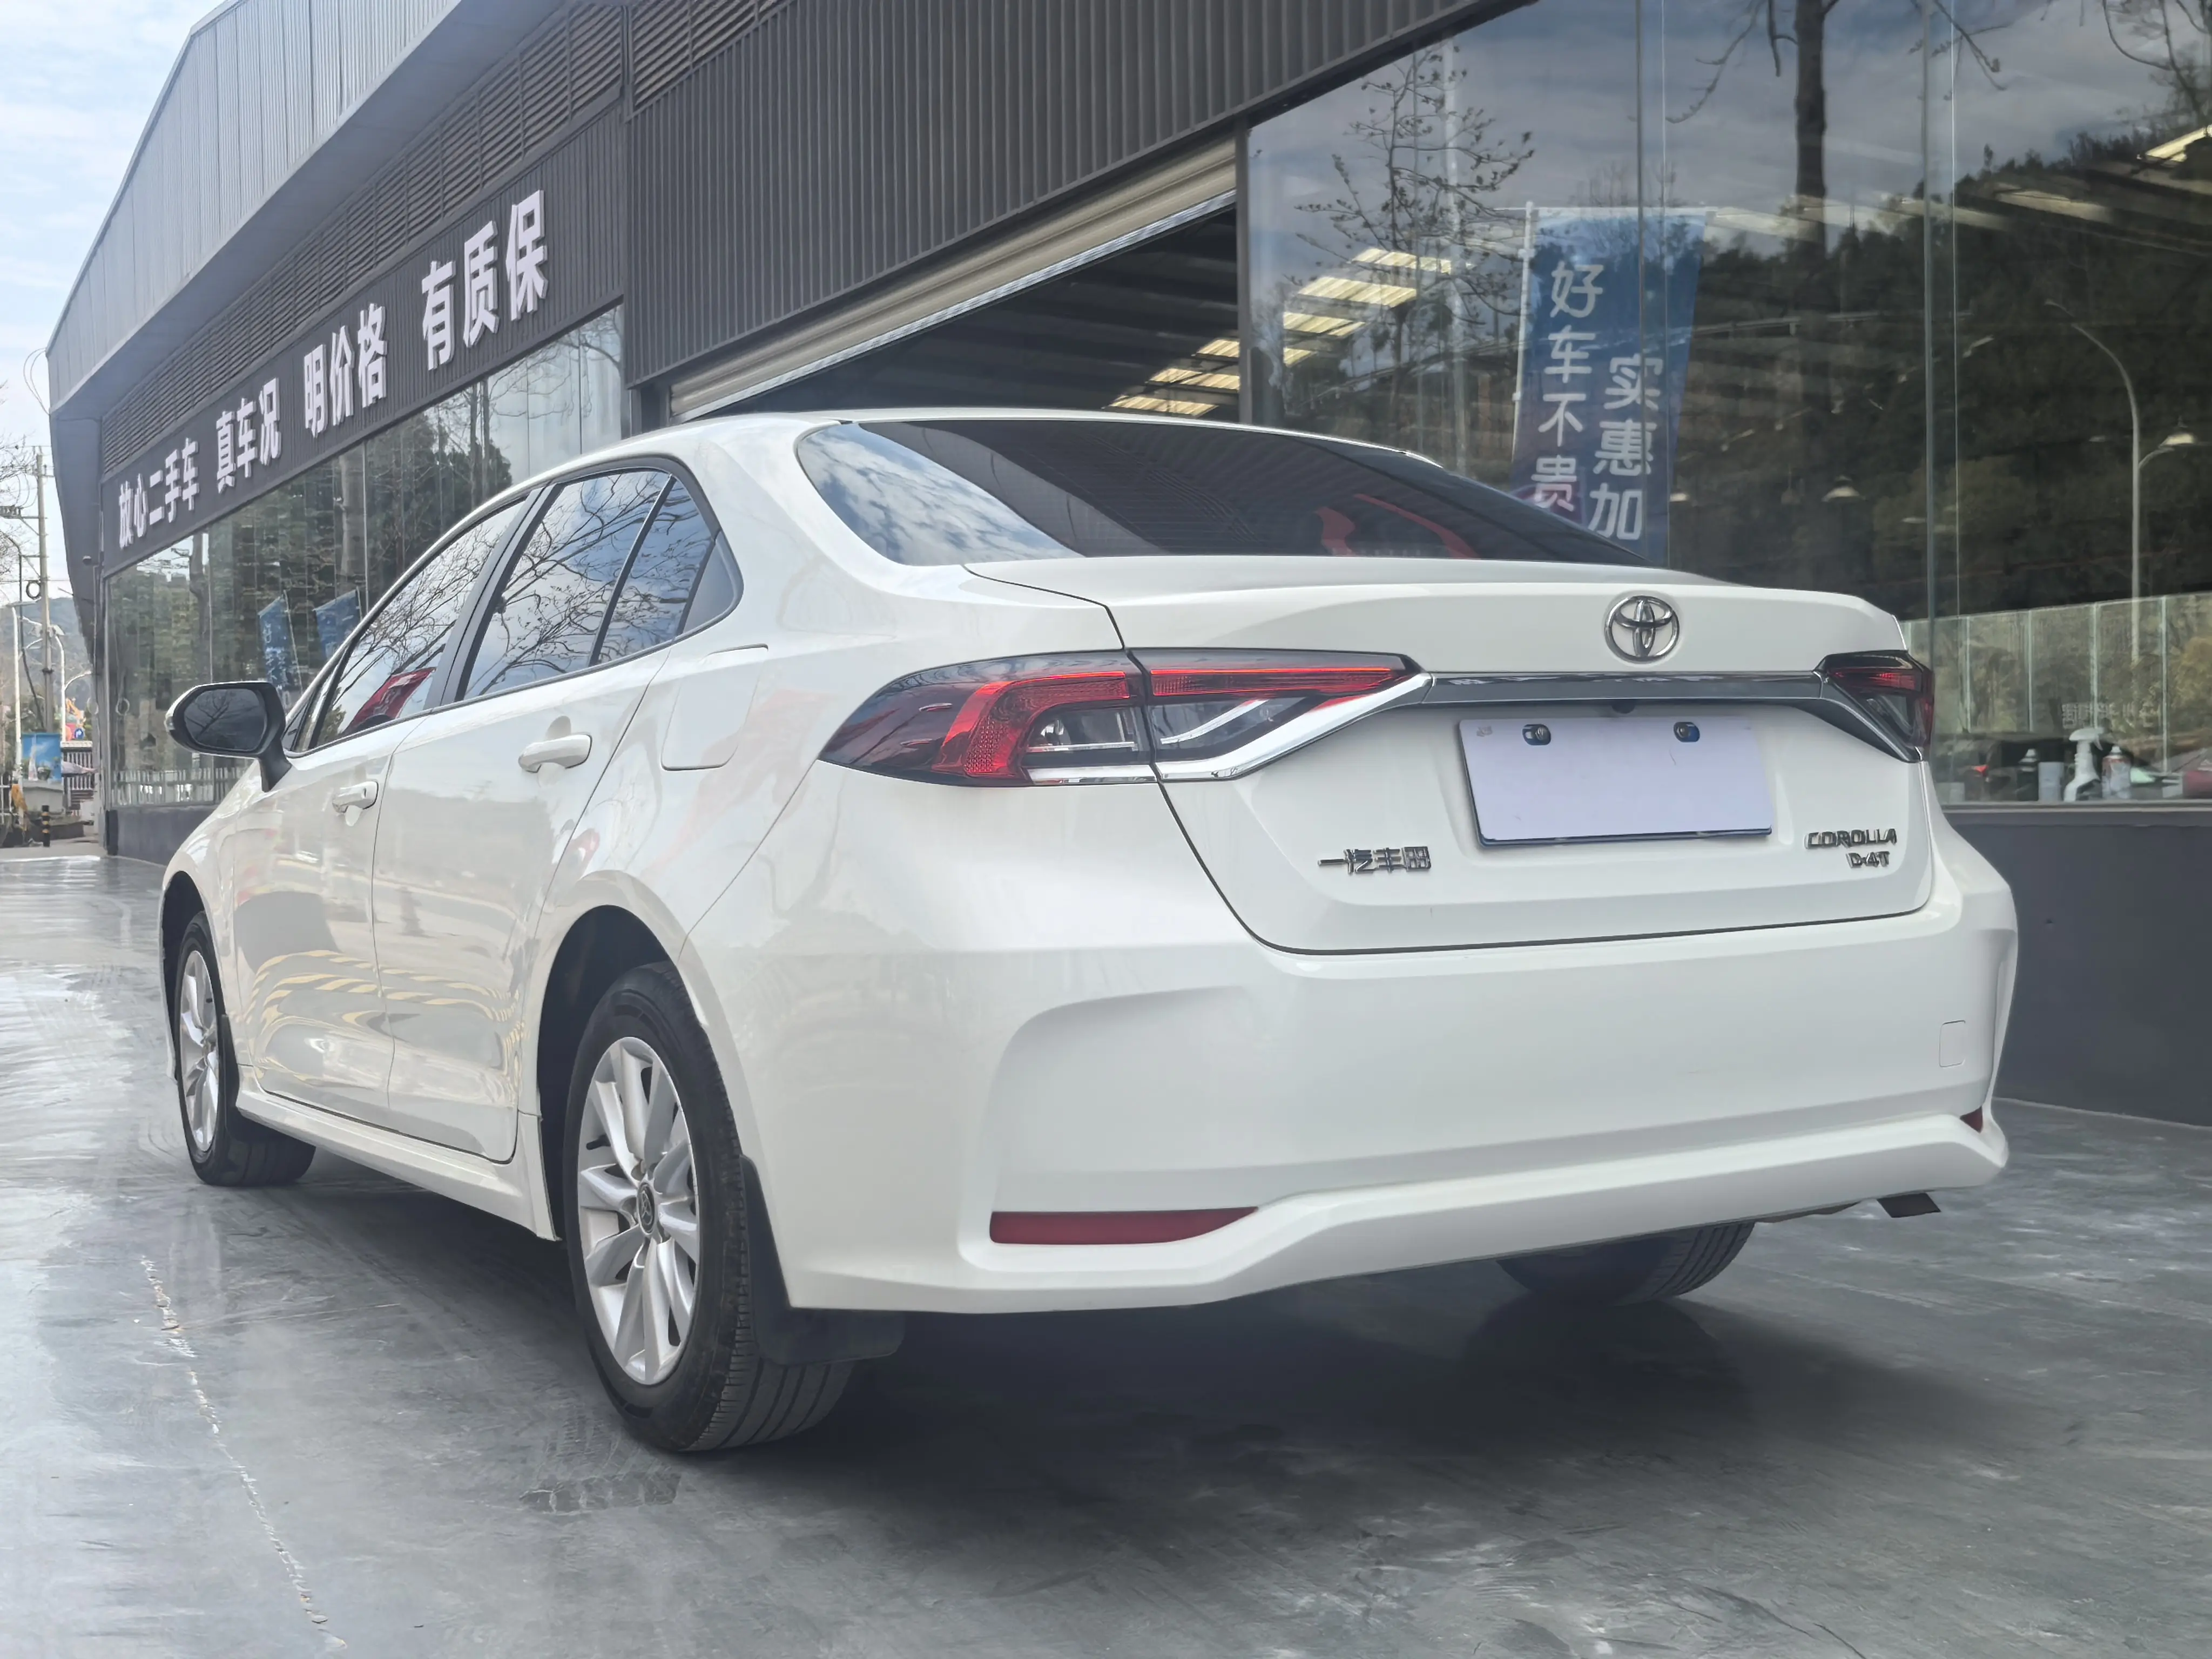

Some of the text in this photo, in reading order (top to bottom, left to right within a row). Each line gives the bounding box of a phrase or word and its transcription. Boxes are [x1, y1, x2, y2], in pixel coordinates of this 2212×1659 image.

[119, 190, 548, 549] 放心二手车 真车况 明价格 有质保
[1531, 260, 1604, 512] 好车不贵
[1587, 353, 1664, 540] 实惠加
[1317, 846, 1432, 874] 一汽丰田
[1804, 828, 1897, 849] COROLLA
